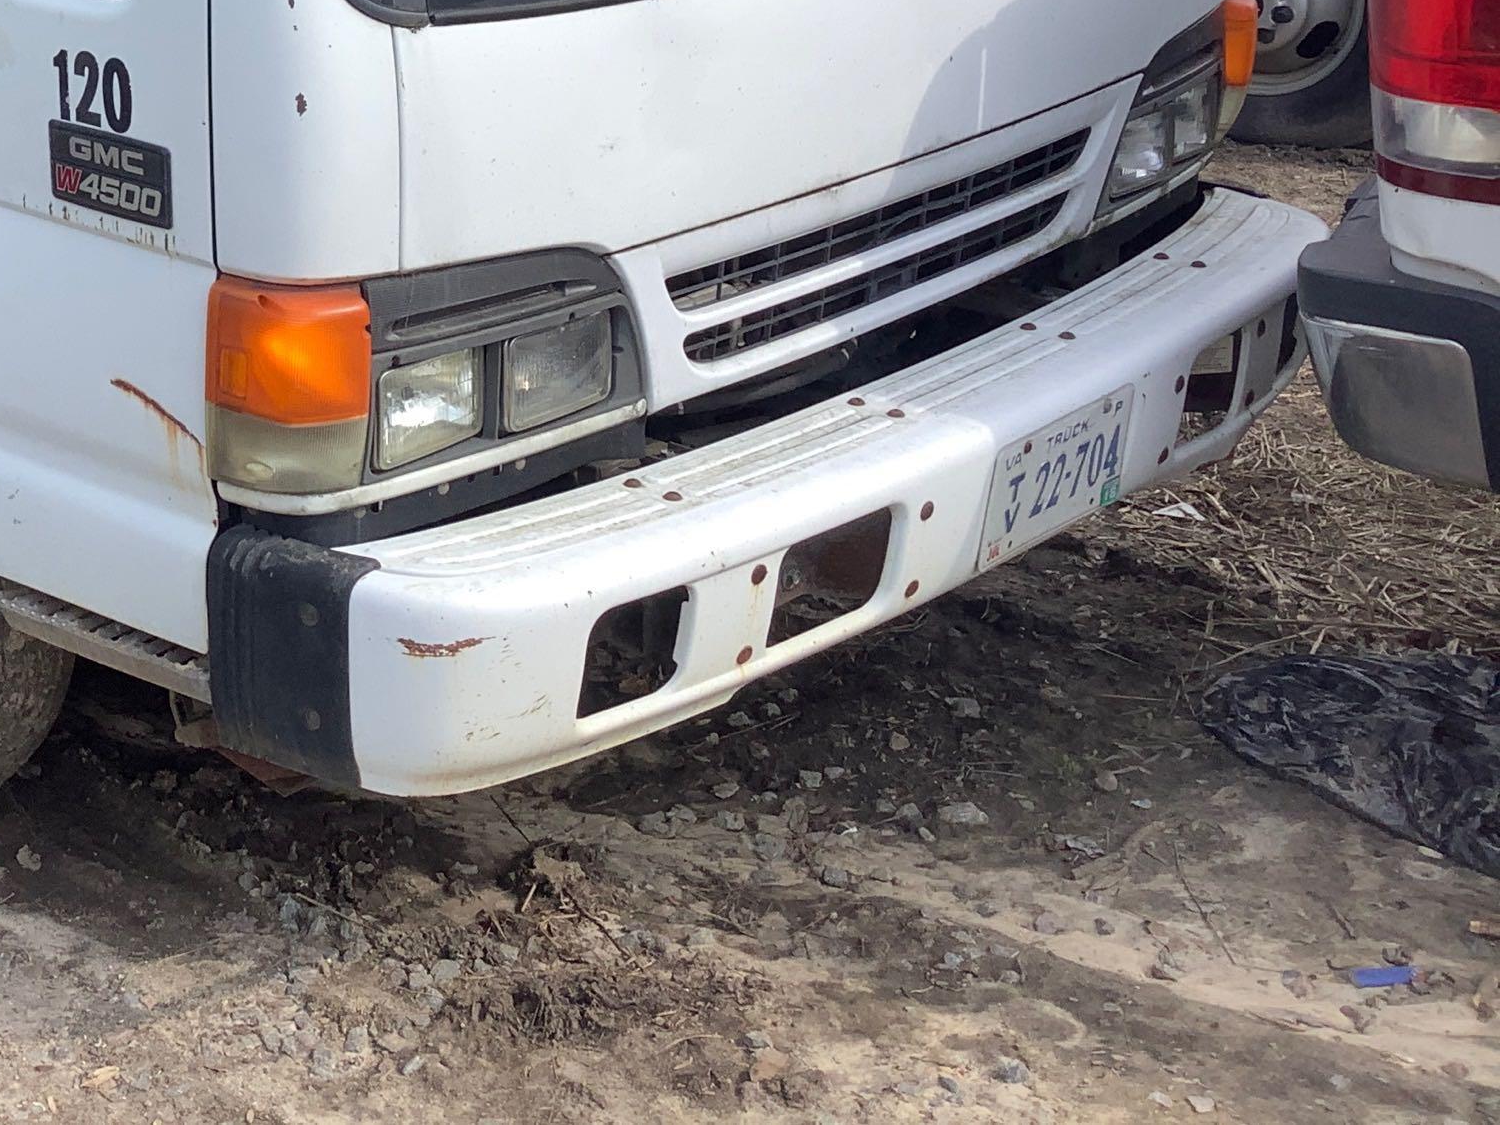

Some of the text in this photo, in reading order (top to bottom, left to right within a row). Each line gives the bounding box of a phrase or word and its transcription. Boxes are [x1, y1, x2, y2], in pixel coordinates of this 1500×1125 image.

[52, 48, 133, 134] 120
[68, 135, 145, 176] GMC
[54, 163, 163, 218] W4500
[1046, 418, 1091, 449] TRUCK
[1028, 423, 1121, 520] 22-704
